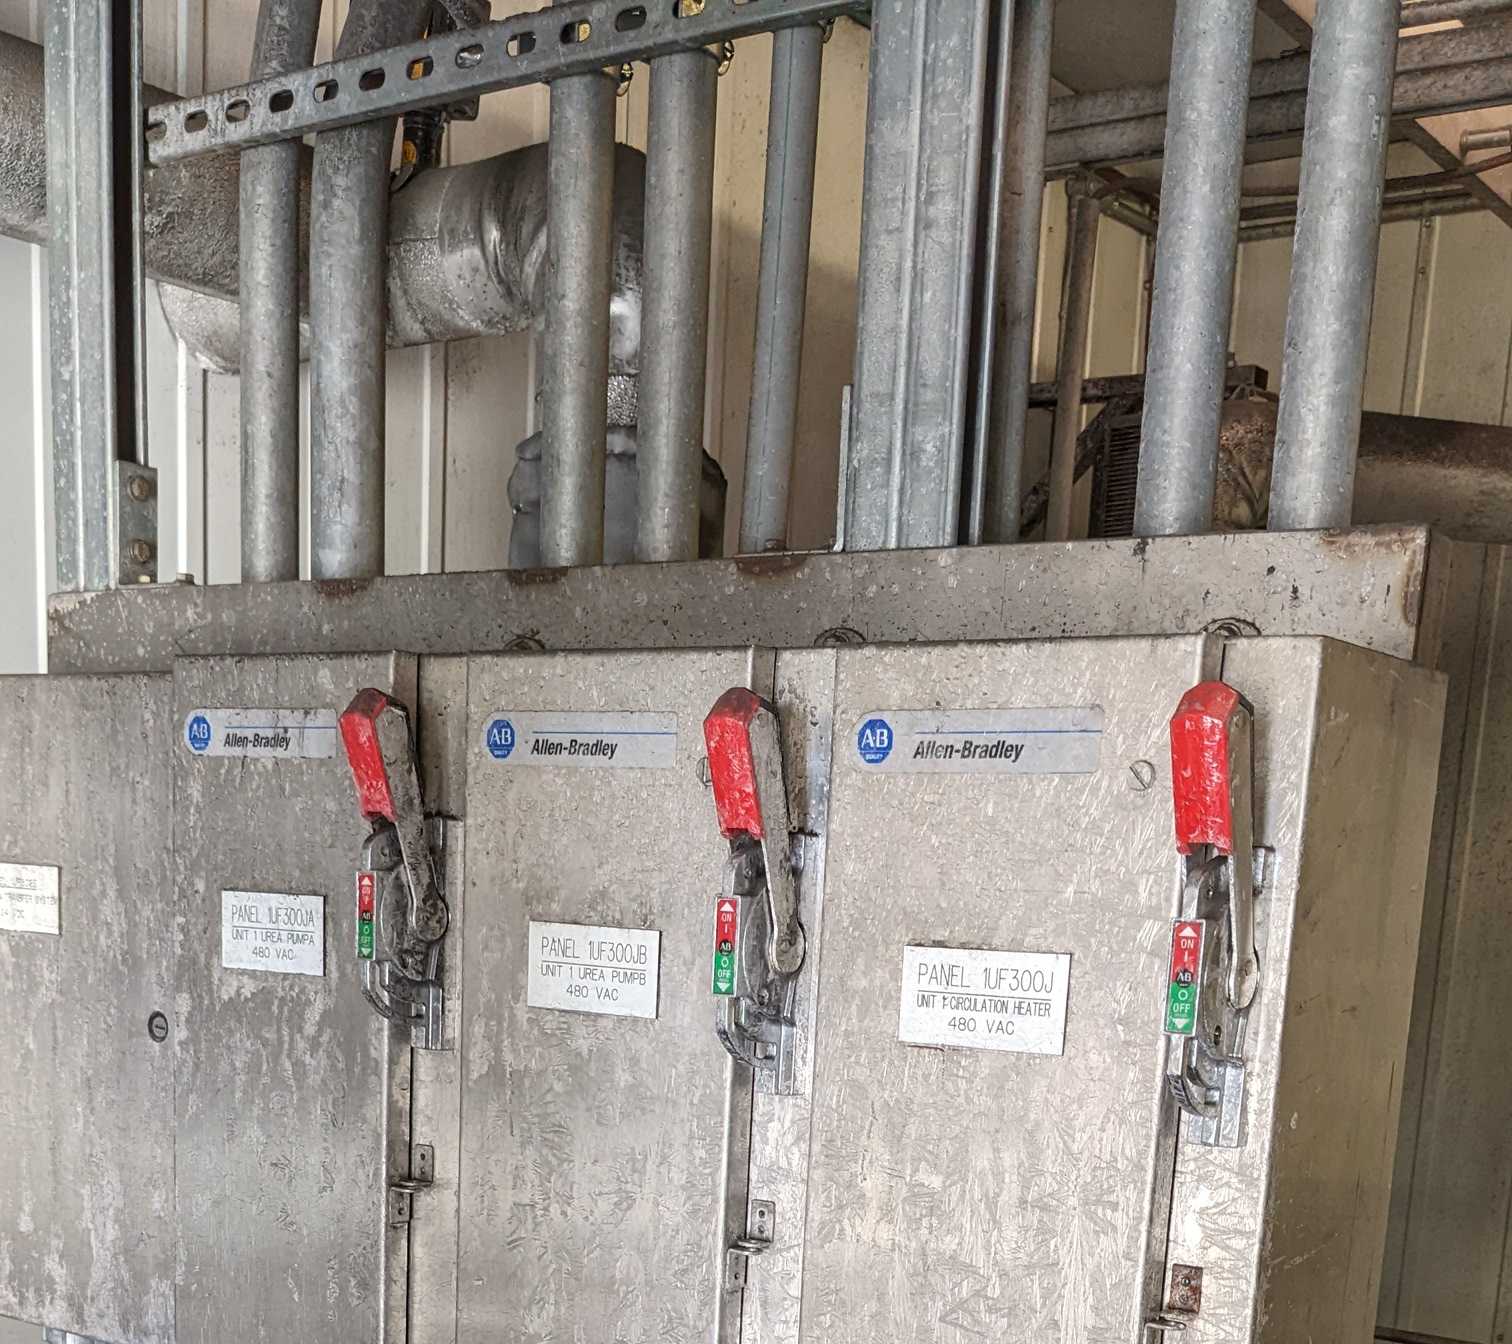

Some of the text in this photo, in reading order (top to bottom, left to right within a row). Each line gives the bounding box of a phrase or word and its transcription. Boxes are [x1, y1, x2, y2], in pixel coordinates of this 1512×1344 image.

[224, 732, 291, 751] Allen-Bradley
[531, 738, 618, 760] Allen-Bradley
[913, 740, 1024, 763] Allen-Bradley
[232, 904, 315, 927] PANEL 1UF300JA
[721, 913, 732, 922] ON
[232, 929, 249, 940] UNIT
[261, 931, 282, 943] UREA
[287, 932, 315, 945] PUMPA
[1181, 939, 1194, 949] ON
[252, 946, 294, 960] 480 VAC
[541, 936, 647, 964] PANEL 1UF300JB
[541, 964, 562, 977] UNIT
[578, 967, 605, 982] UREA
[611, 970, 646, 985] PUMPB
[718, 970, 731, 978] OFF
[918, 962, 1054, 993] PANEL 1UF300J
[1177, 973, 1192, 982] AB
[566, 984, 619, 1001] 480 VAC
[916, 994, 937, 1008] UNIT
[950, 996, 1008, 1014] CIRCULATION
[1013, 1001, 1051, 1017] HEATER
[1173, 1003, 1190, 1013] OFF
[948, 1017, 1015, 1035] 480 VAC
